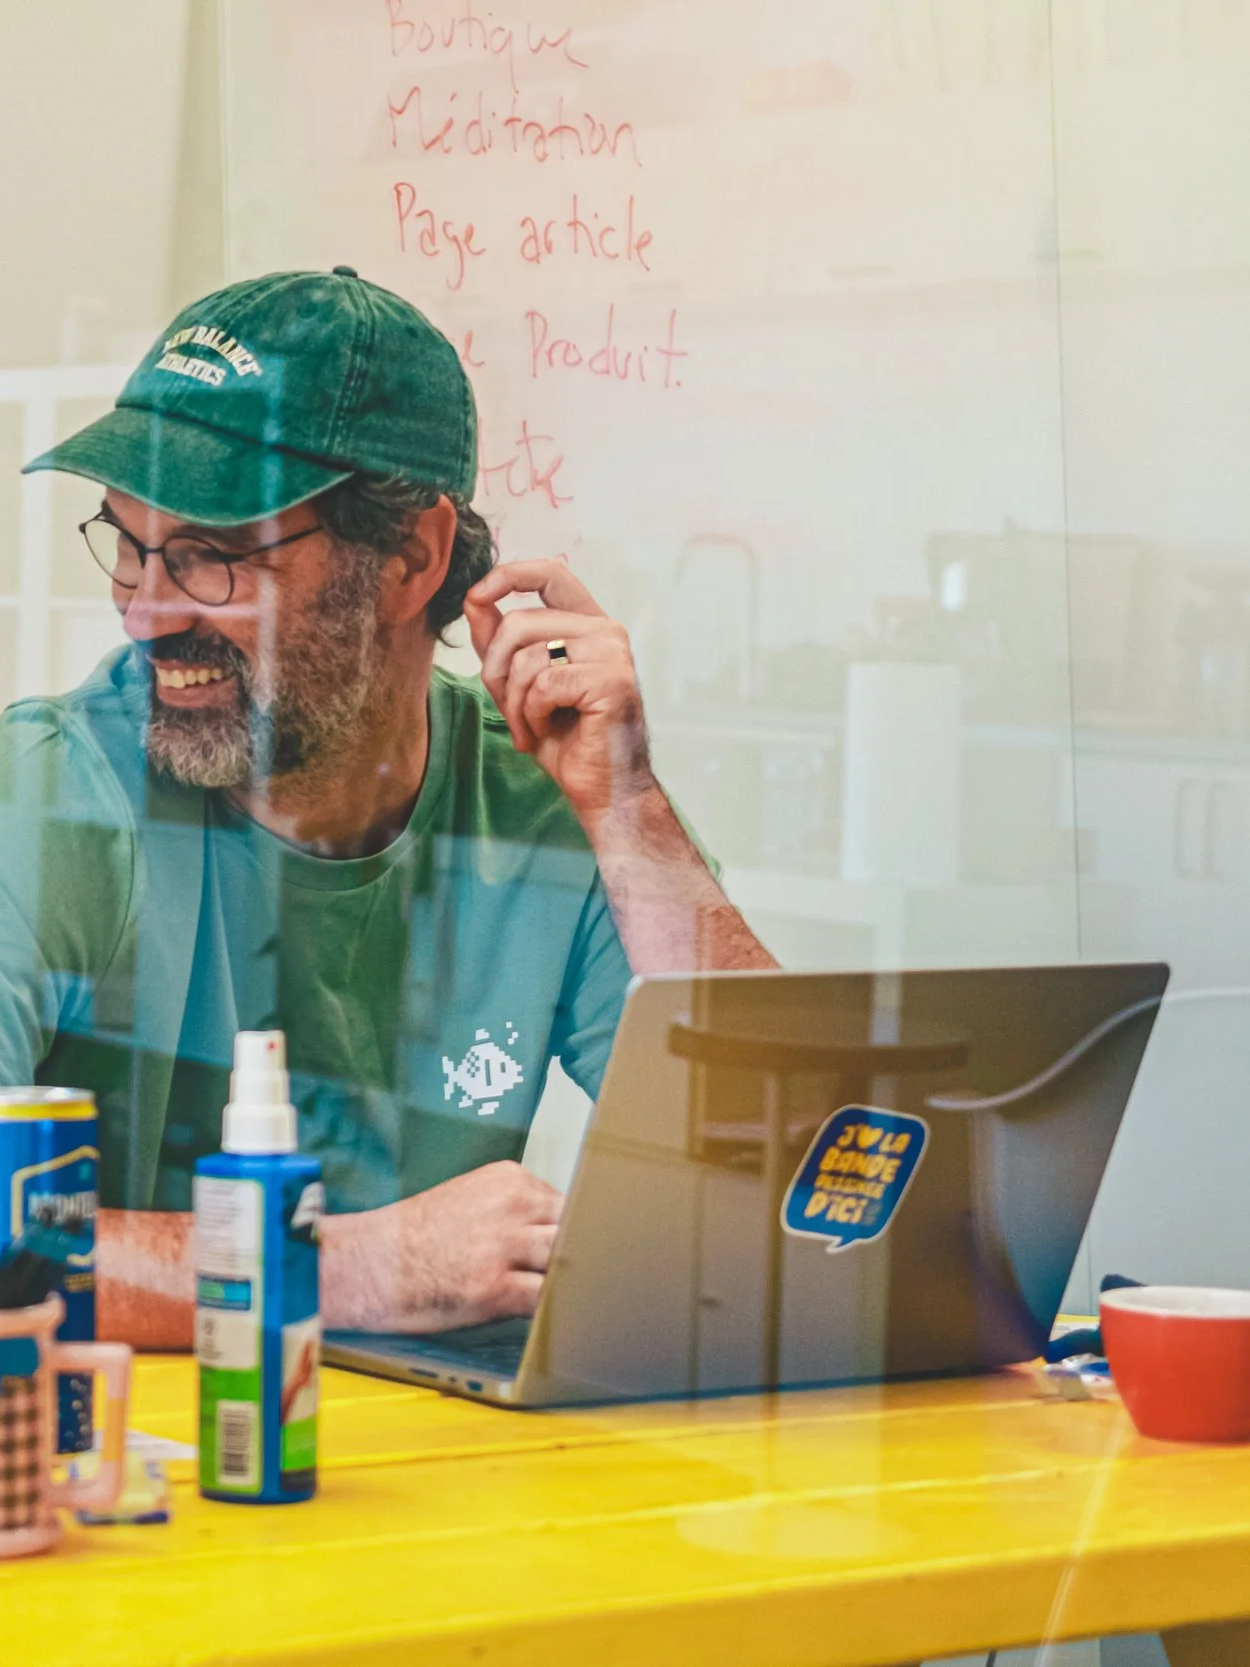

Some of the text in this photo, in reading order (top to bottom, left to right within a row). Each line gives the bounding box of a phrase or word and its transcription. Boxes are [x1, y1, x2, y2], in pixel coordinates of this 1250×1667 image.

[385, 0, 589, 94] Boutique
[387, 86, 642, 167] Méditation
[394, 182, 653, 291] Page article
[191, 325, 263, 377] BALANCE
[818, 1146, 902, 1183] BANDE
[878, 1132, 912, 1154] LA
